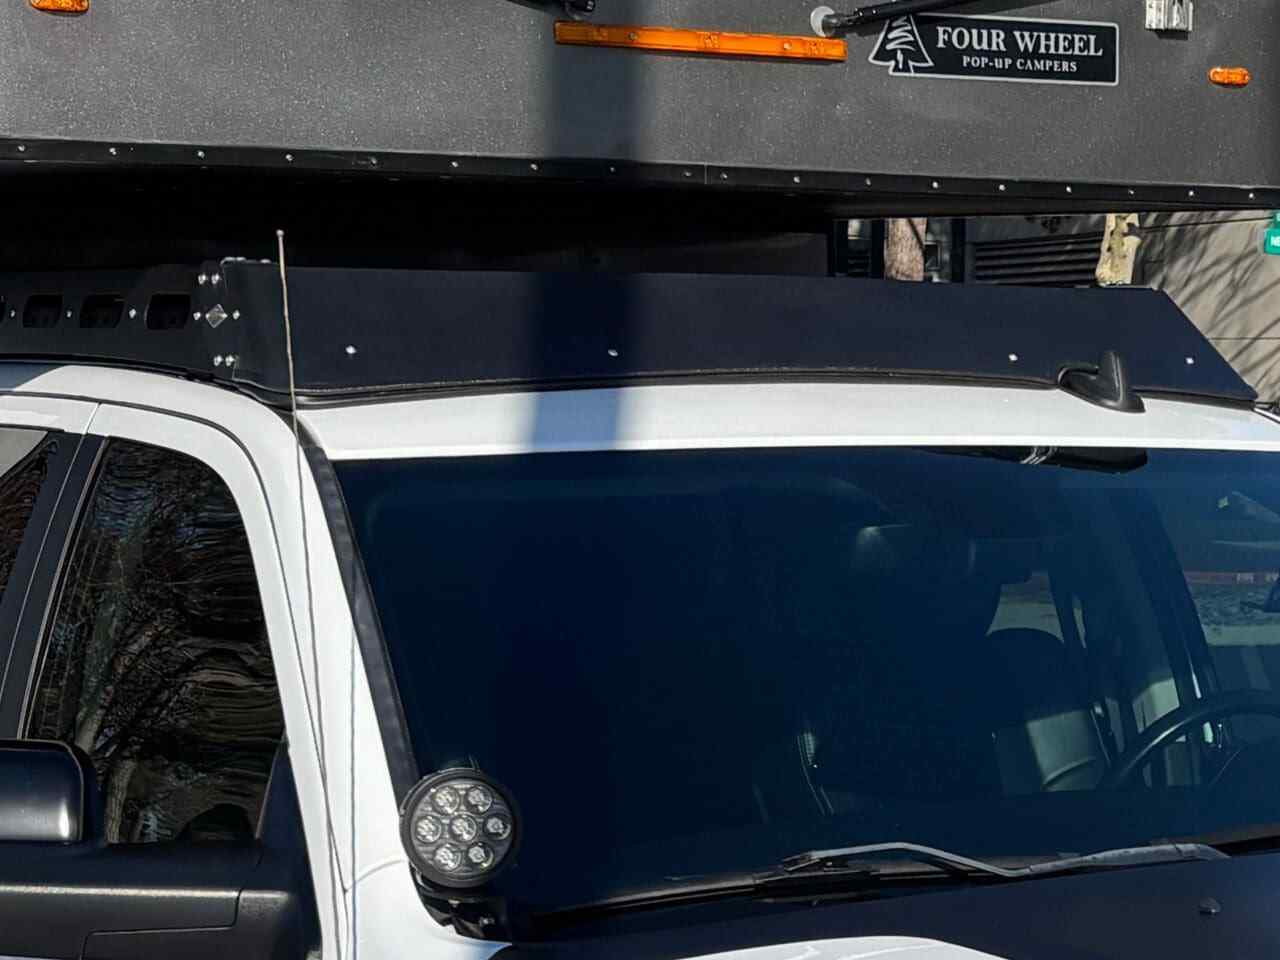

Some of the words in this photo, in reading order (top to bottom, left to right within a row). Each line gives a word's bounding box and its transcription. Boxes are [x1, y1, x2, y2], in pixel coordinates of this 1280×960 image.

[936, 26, 1006, 52] FOUR
[1013, 31, 1103, 57] WHEEL
[962, 55, 1012, 70] POP-UP
[1016, 58, 1078, 73] CAMPERS
